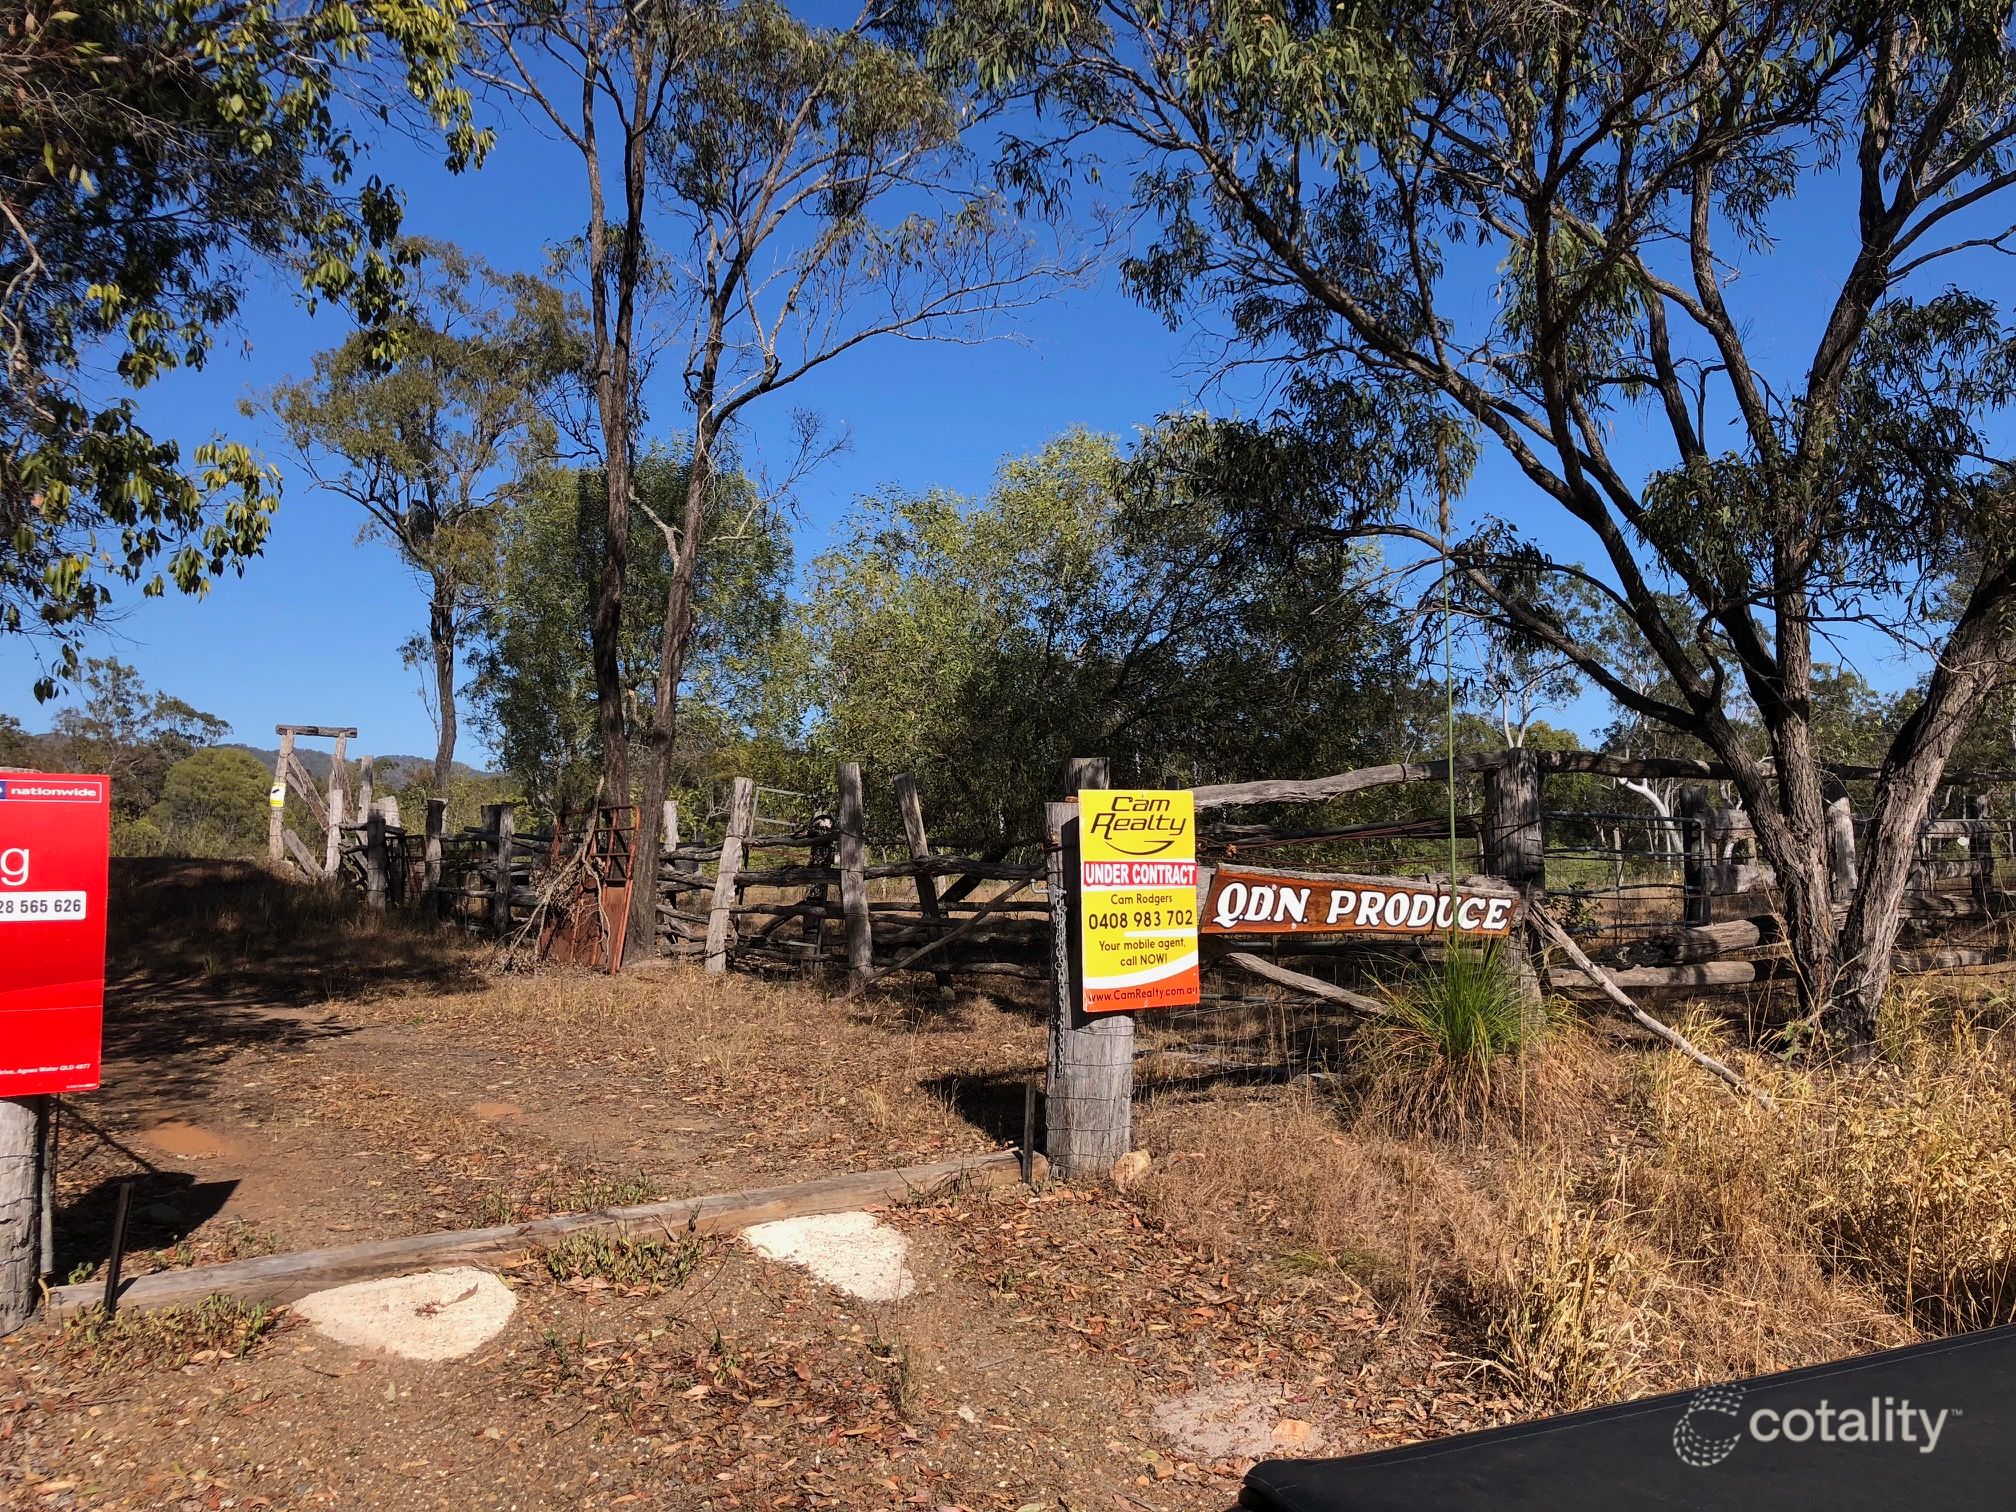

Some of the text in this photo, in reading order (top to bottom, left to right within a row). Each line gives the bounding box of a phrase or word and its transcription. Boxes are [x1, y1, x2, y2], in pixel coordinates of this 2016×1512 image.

[11, 787, 97, 797] nationwide
[1111, 796, 1170, 812] Cam
[1090, 812, 1187, 840] Realty
[1085, 863, 1195, 885] UNDER CONTRACT
[20, 900, 48, 914] 565
[54, 899, 82, 913] 626
[1110, 893, 1173, 906] Cam Rodgers
[1326, 889, 1512, 931] PRODUCE
[1088, 909, 1193, 930] 0408 983 702
[1099, 940, 1121, 951] Your
[1124, 938, 1155, 950] mobile
[1120, 953, 1168, 967] call NOW!
